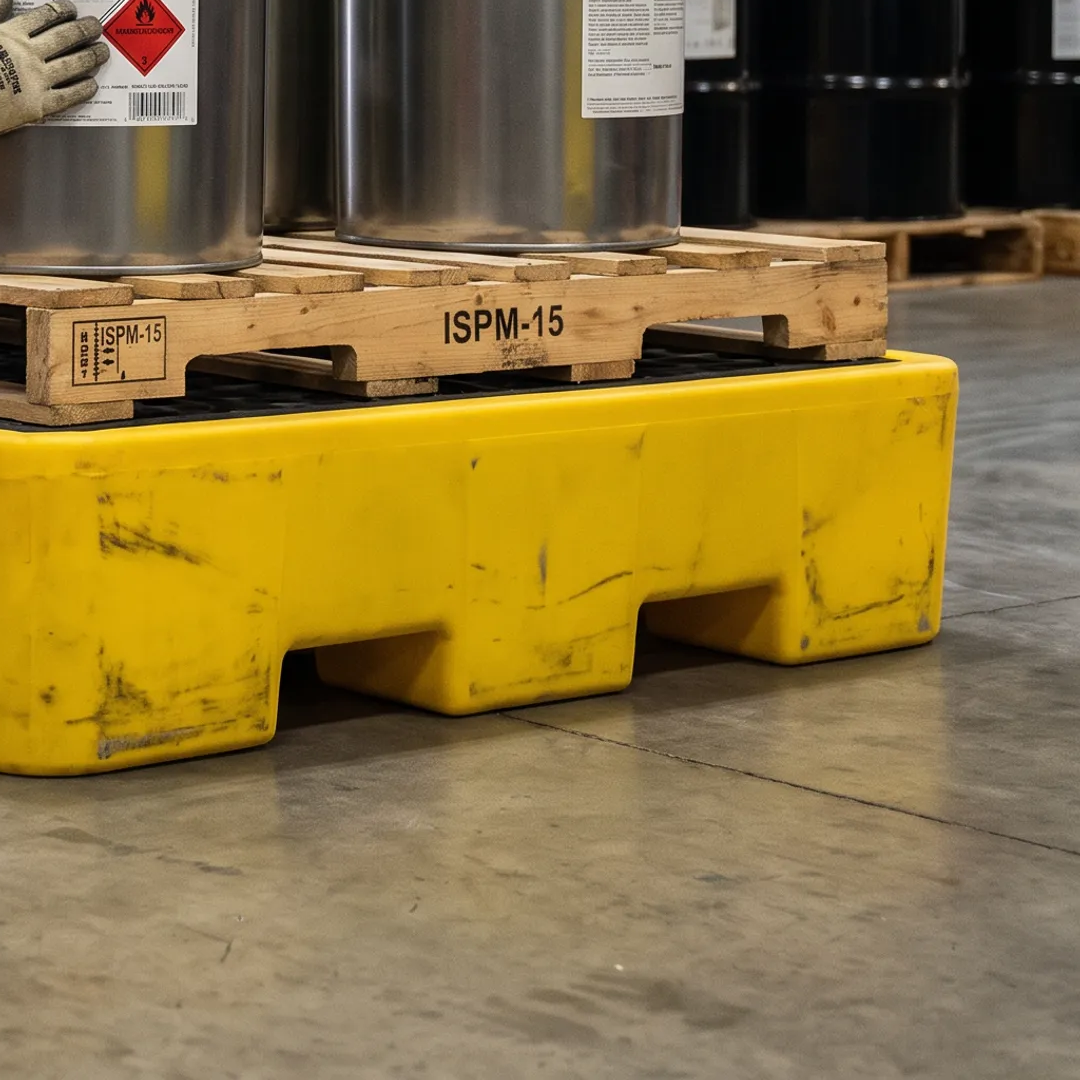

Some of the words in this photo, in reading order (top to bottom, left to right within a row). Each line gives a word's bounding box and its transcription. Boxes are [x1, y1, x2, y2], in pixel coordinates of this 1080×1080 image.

[141, 55, 148, 66] 3
[100, 323, 162, 347] ISPM-15
[443, 304, 565, 345] ISPM-15
